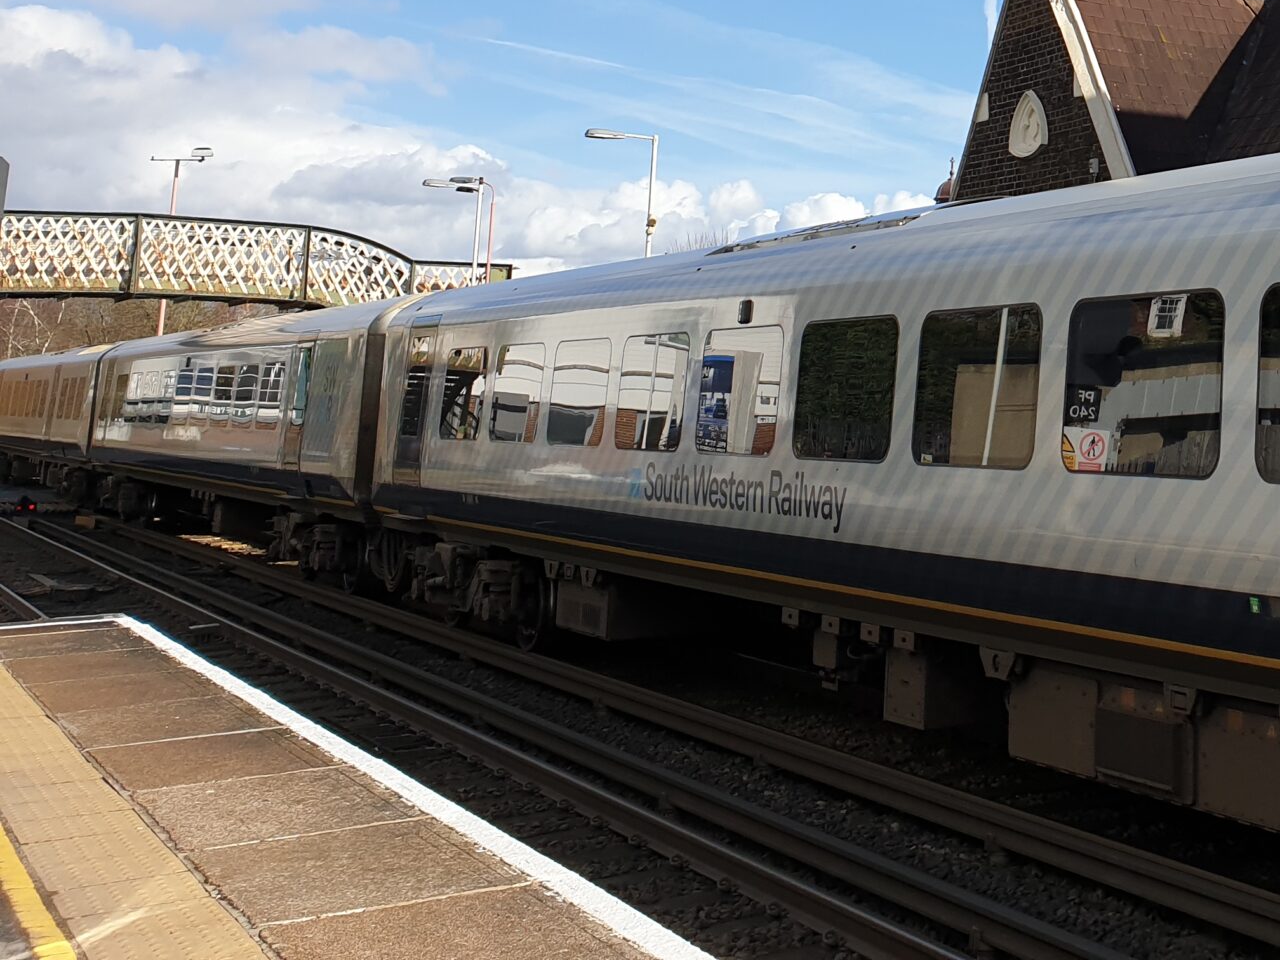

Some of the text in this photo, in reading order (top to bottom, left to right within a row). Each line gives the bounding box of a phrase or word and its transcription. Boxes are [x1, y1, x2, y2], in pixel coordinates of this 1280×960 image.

[644, 461, 848, 534] South Western Railway
